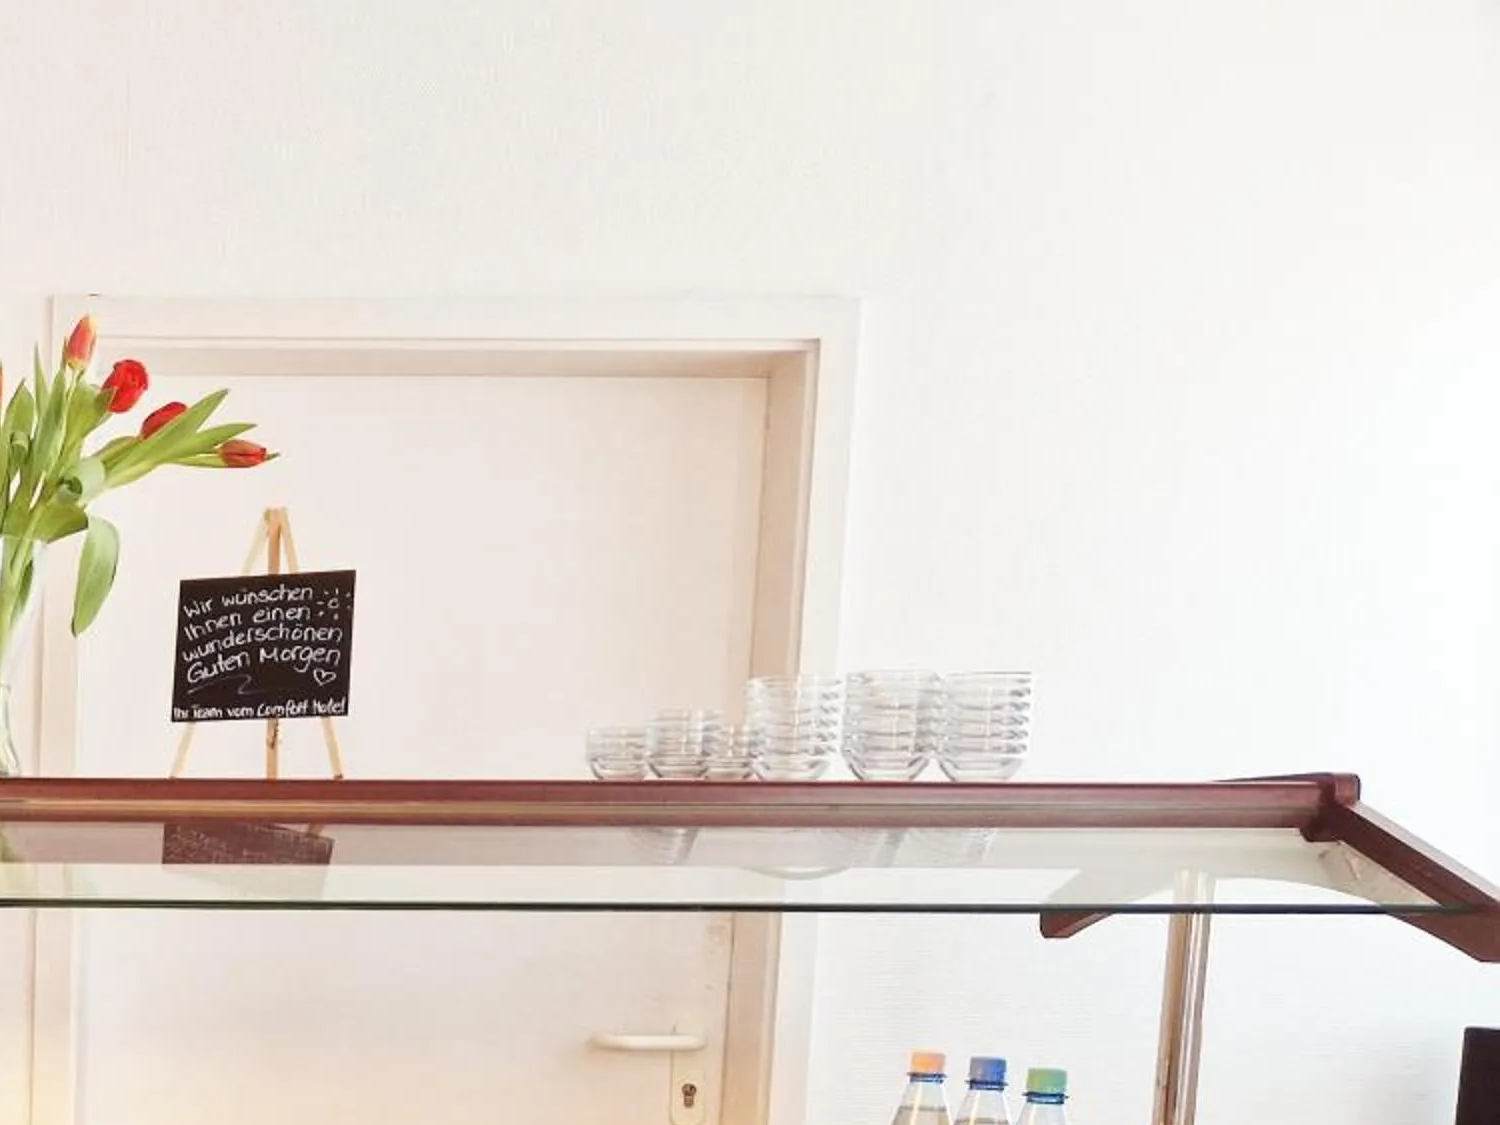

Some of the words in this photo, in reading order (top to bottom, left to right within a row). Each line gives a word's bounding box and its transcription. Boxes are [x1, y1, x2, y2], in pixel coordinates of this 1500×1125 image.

[183, 598, 213, 619] Wir
[221, 583, 313, 607] wünschen
[184, 612, 242, 641] Ihnen
[252, 606, 311, 623] einen
[182, 623, 343, 662] wunderschönen
[187, 651, 250, 683] Guten
[259, 645, 341, 673] Morgen
[173, 707, 191, 719] Ihr
[192, 704, 223, 718] Team
[227, 706, 255, 718] vom
[313, 696, 347, 714] Hotel
